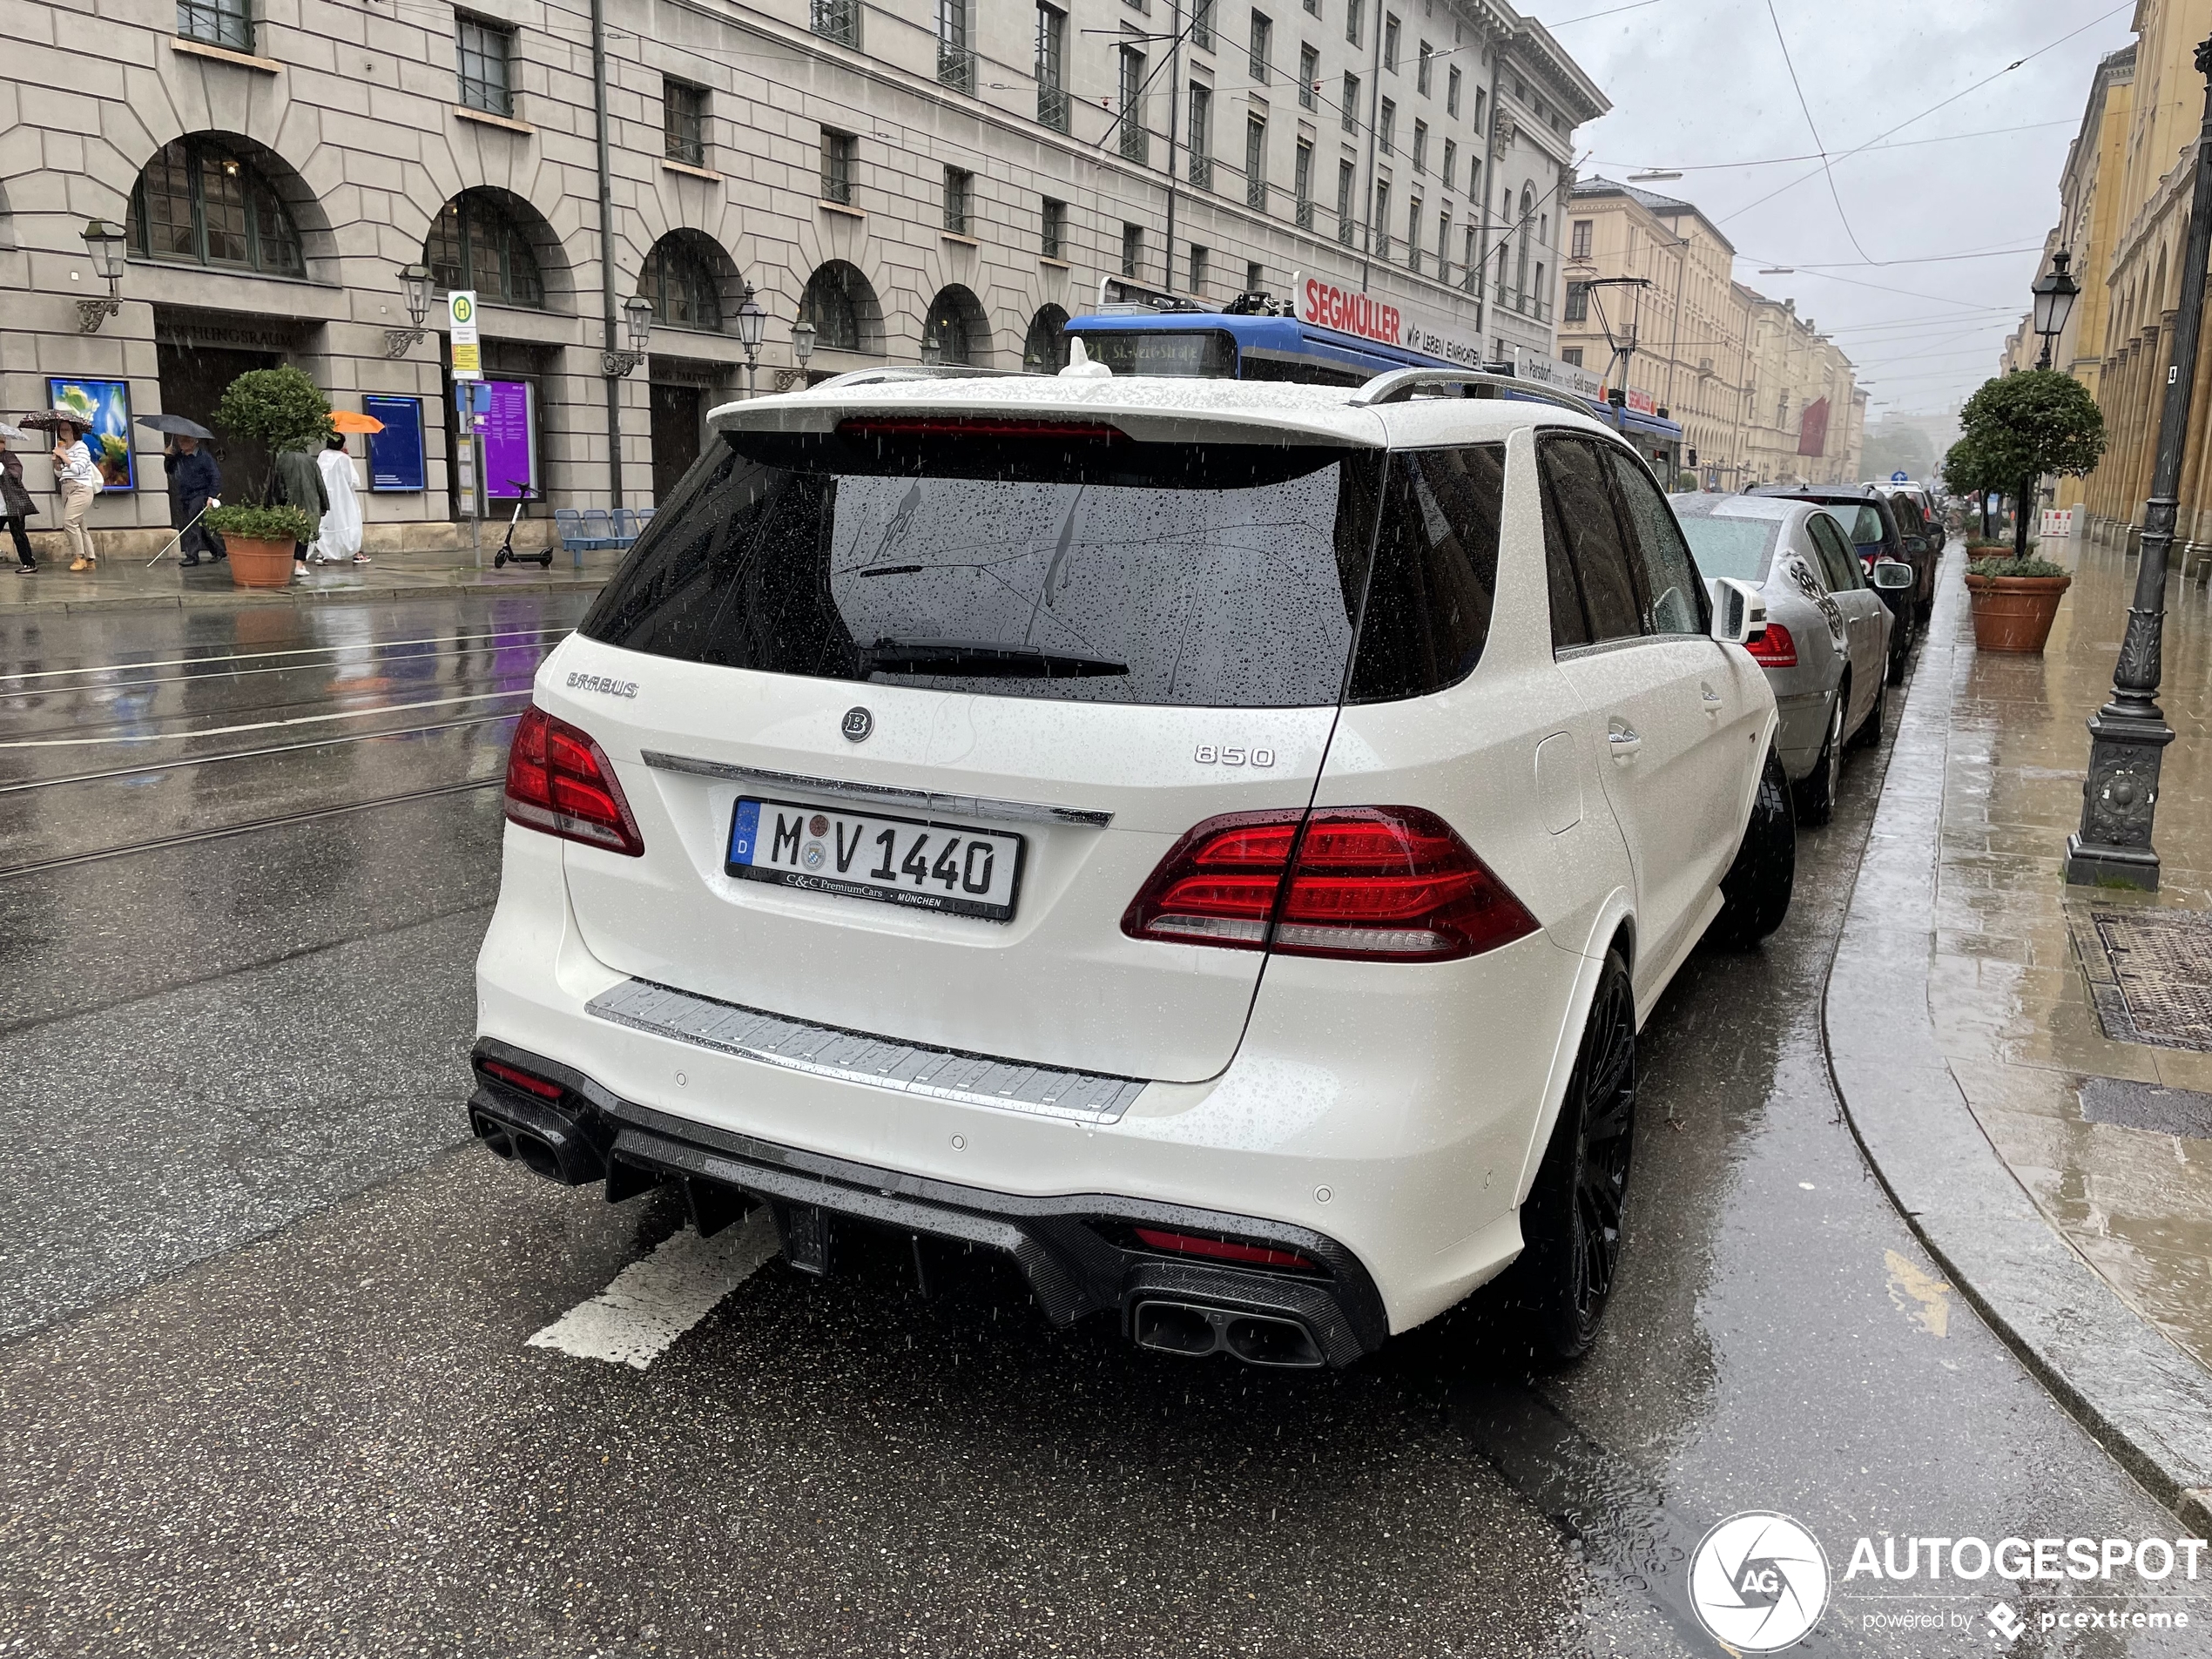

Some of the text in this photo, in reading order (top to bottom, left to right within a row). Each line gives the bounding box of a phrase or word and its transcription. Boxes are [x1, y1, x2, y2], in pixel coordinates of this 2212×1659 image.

[457, 301, 467, 318] H
[1305, 278, 1401, 346] SEGMÜLLER
[1422, 332, 1445, 356] LEBEN
[1529, 358, 1552, 382] Parsdorf
[1574, 372, 1583, 391] Geld
[566, 671, 640, 699] BRABUS
[845, 711, 867, 733] B
[1194, 744, 1276, 768] 850
[737, 840, 748, 855] D
[771, 813, 804, 866] M
[836, 821, 864, 873] V
[870, 828, 995, 895] 1440
[786, 873, 942, 907] C&C PremiumCars MÜNCHEN
